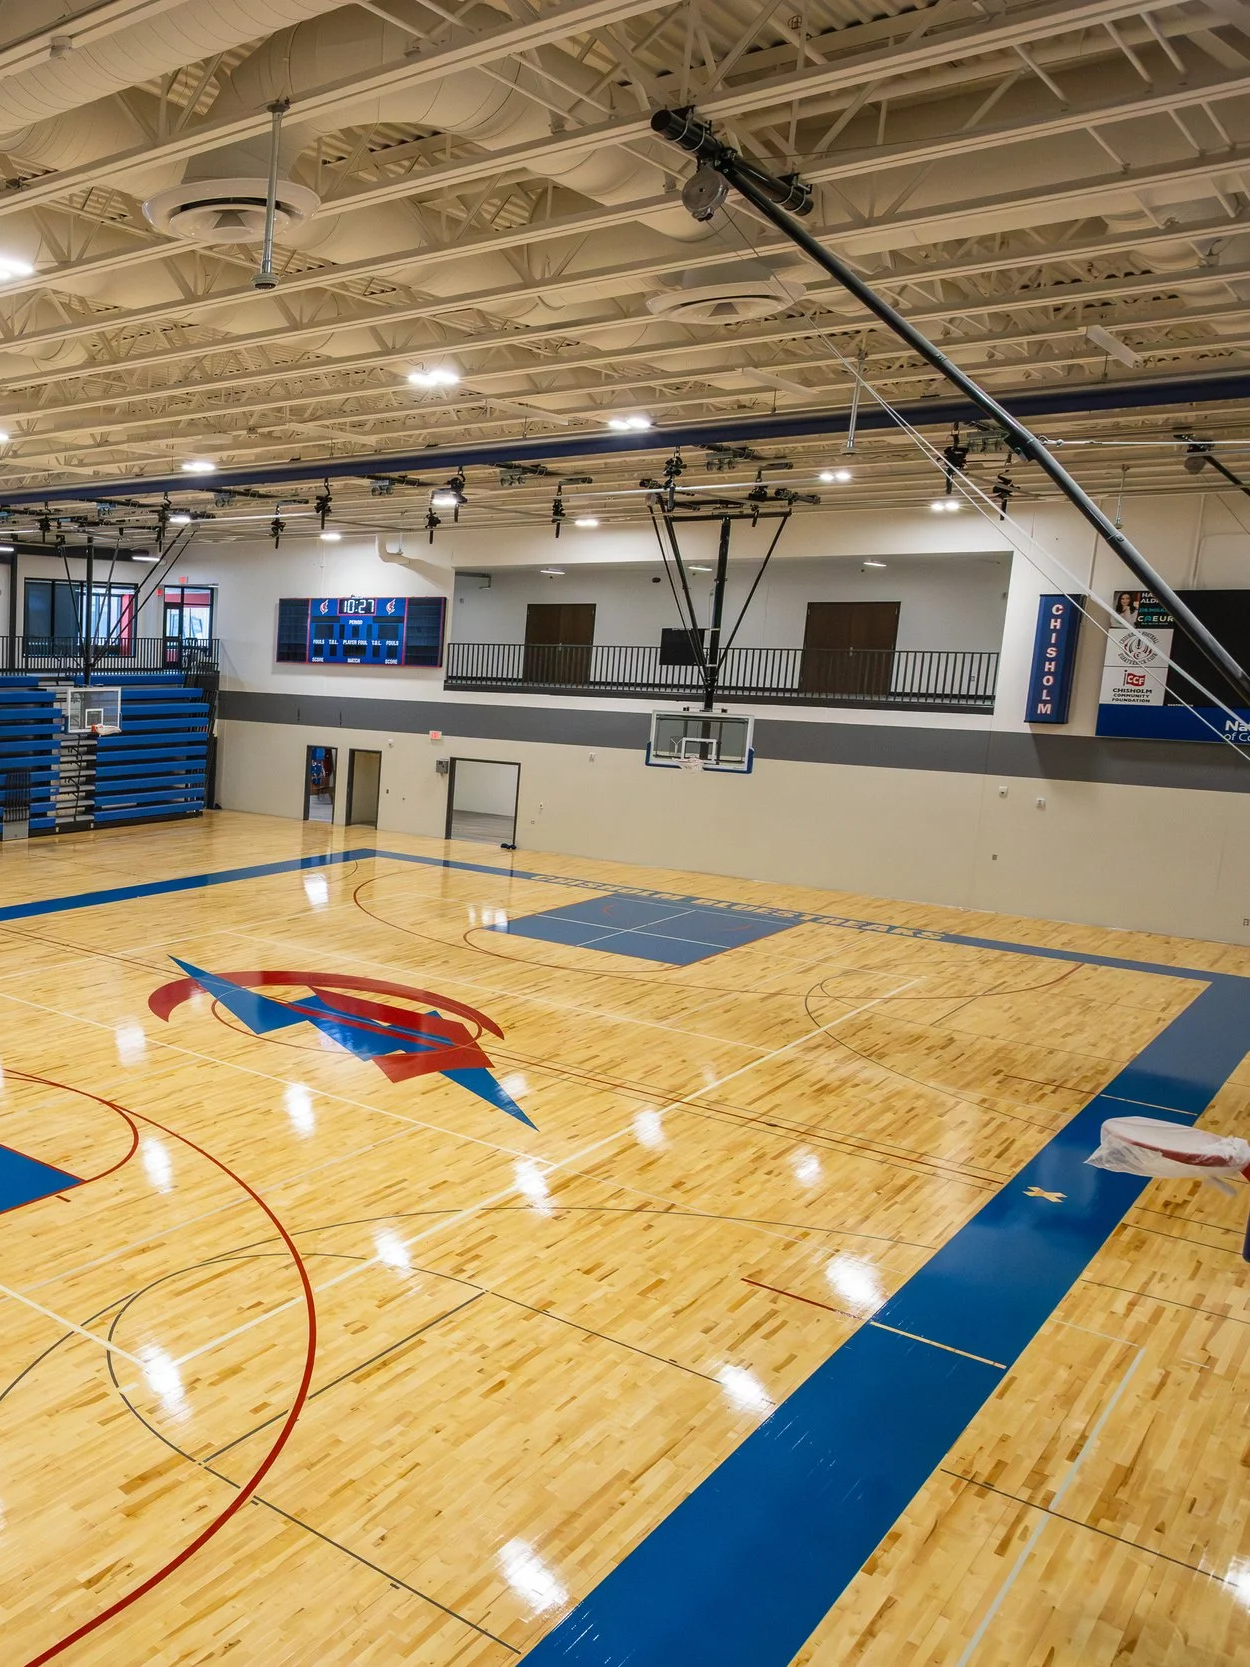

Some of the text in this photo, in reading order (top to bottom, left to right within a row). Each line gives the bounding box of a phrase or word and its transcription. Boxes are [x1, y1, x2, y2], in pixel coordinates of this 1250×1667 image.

[344, 599, 375, 613] 10:27
[1037, 604, 1065, 715] CHISHOLM
[1127, 675, 1145, 685] CCF
[1225, 720, 1250, 731] Na
[1224, 732, 1237, 741] of
[530, 875, 947, 940] CHISHOLM BLUESTREAKS
